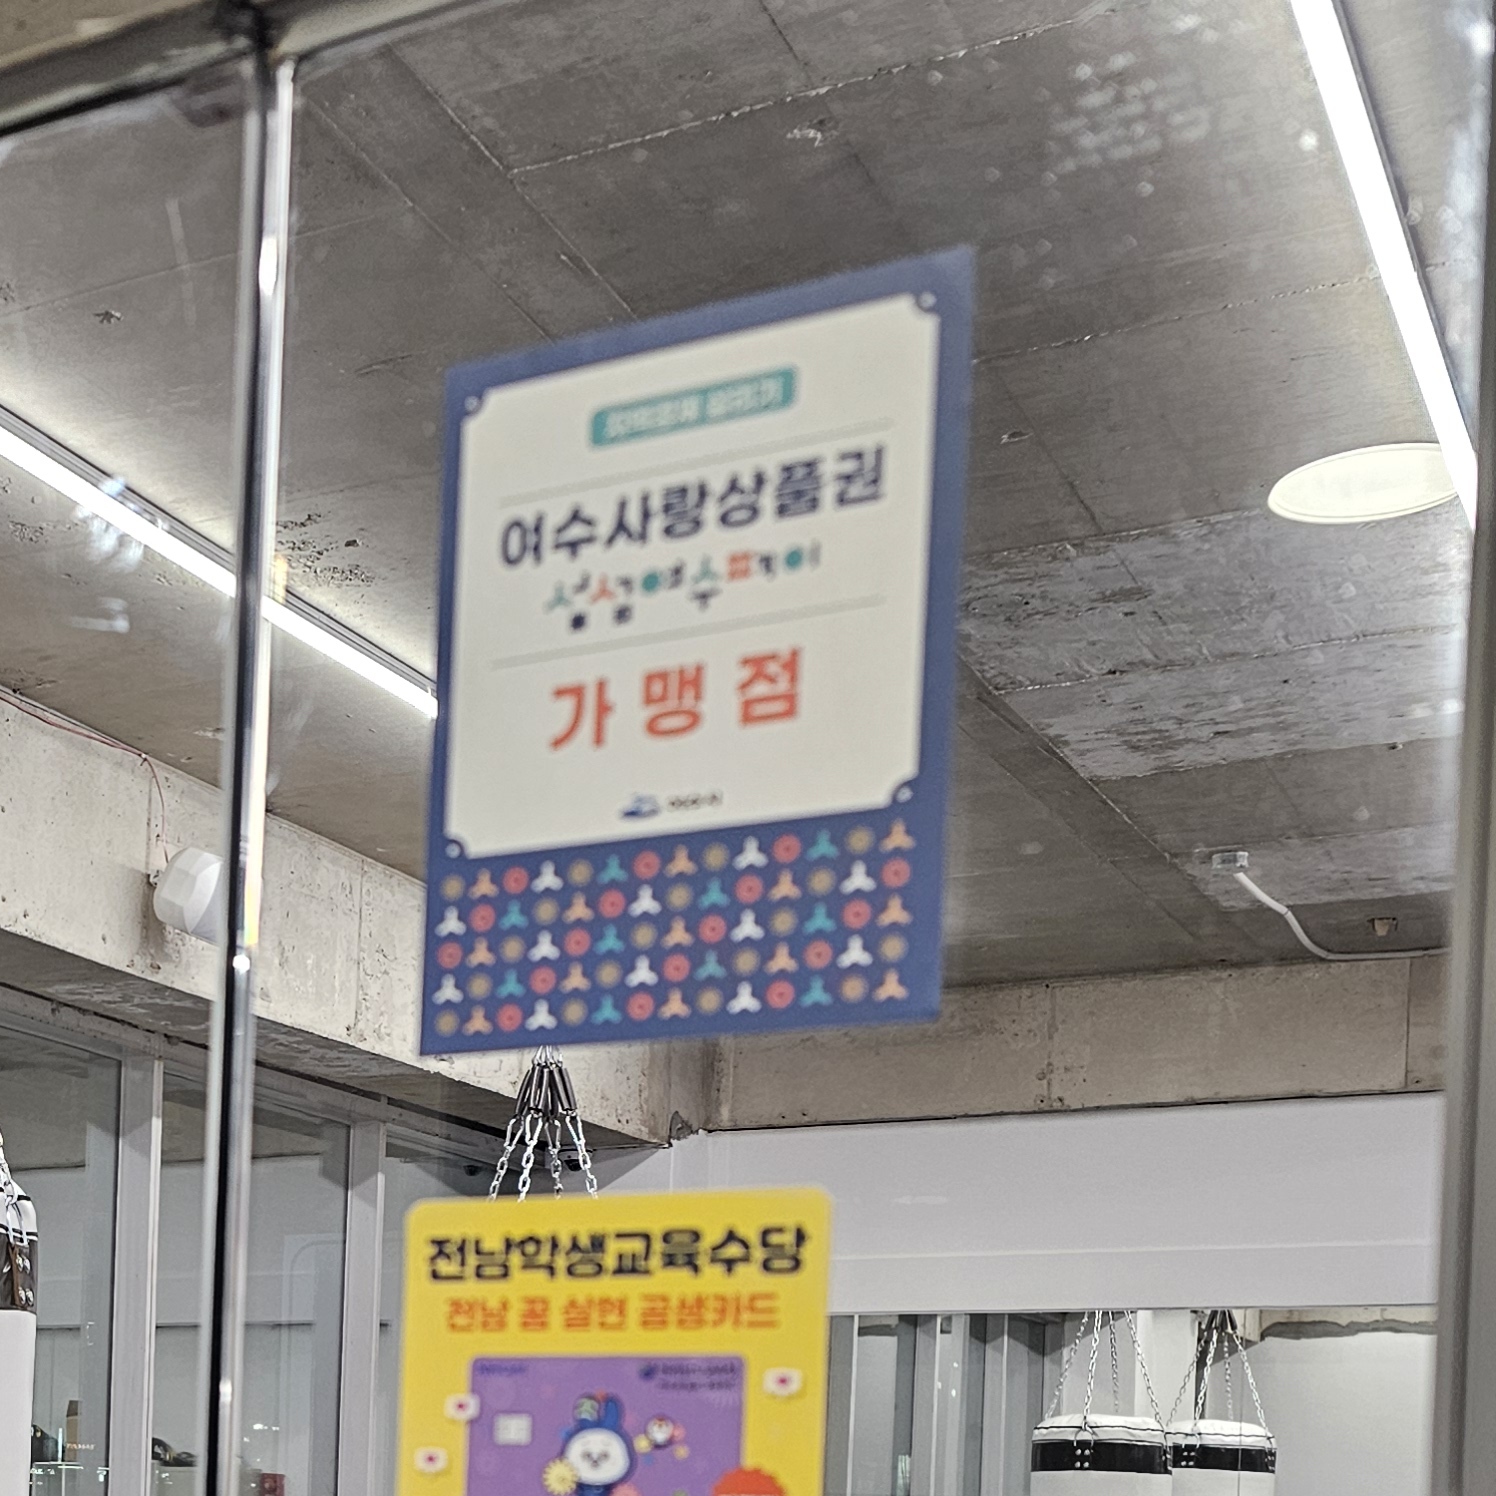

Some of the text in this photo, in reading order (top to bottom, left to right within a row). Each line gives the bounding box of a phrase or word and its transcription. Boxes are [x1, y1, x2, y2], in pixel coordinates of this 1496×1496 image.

[501, 444, 887, 567] 여수사랑상품권
[549, 647, 804, 751] 가맹점
[429, 1226, 808, 1281] 전남학생교육수당
[447, 1297, 508, 1333] 전남
